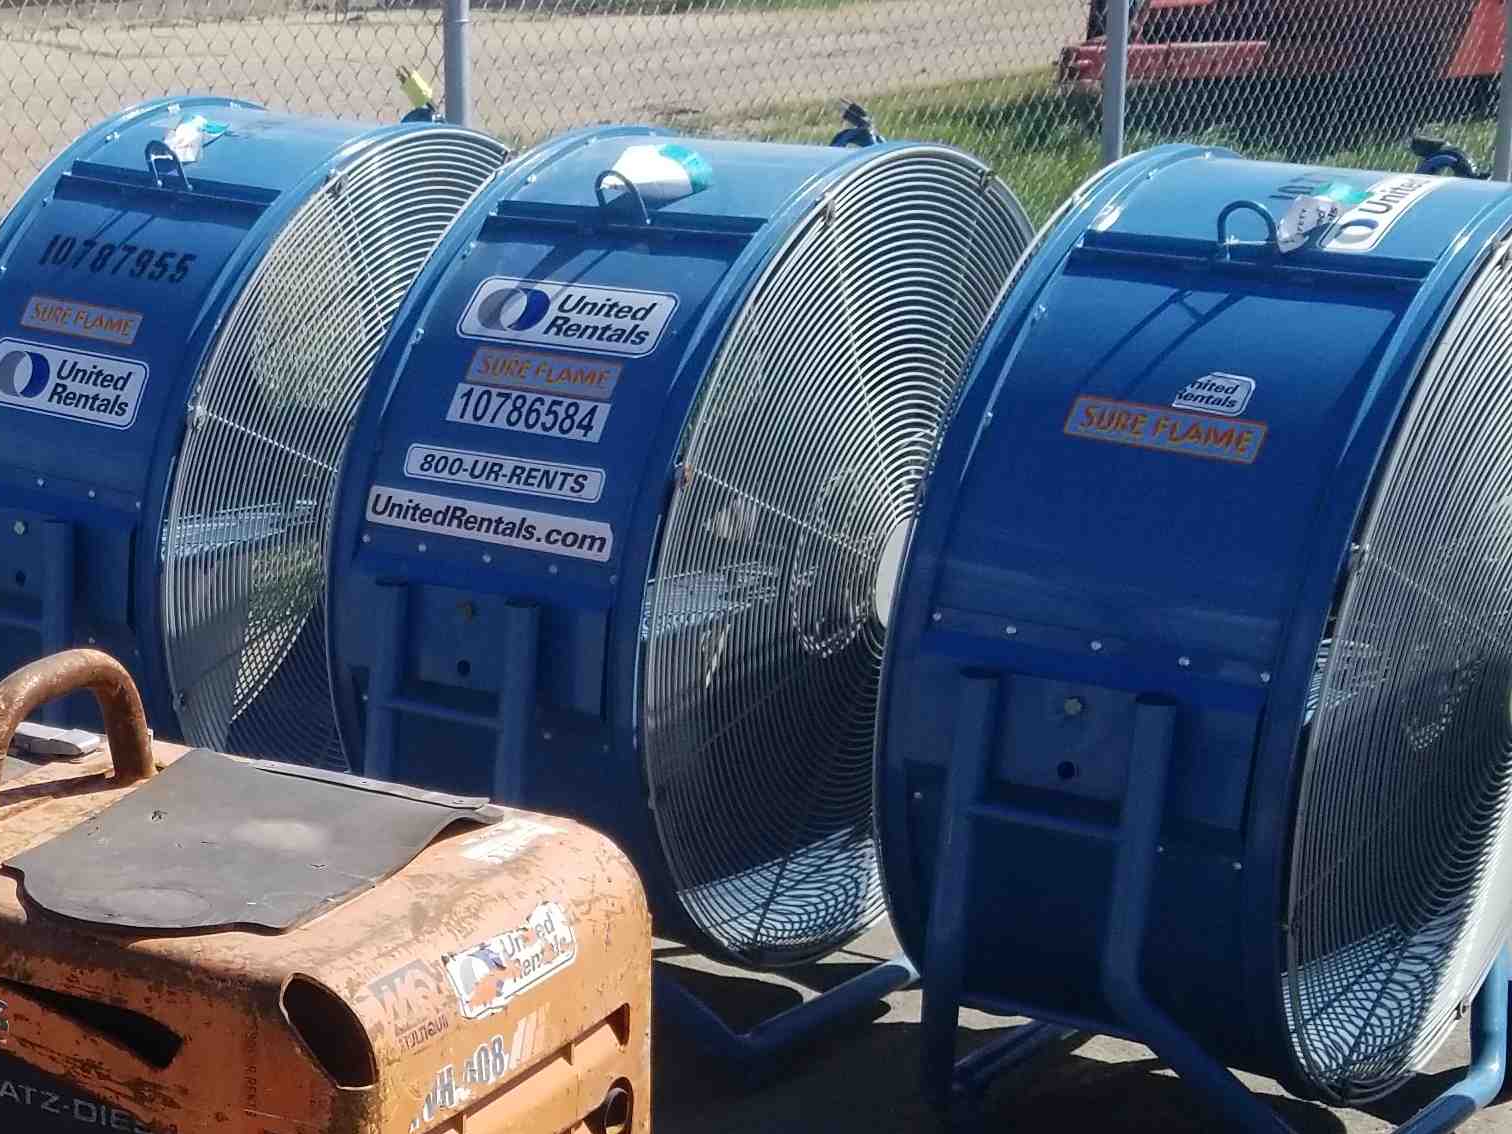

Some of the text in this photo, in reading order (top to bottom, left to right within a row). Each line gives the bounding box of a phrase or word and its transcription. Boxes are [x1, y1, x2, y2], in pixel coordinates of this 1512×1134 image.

[39, 234, 197, 283] 10787955
[34, 303, 133, 337] SURE FLAME
[557, 294, 657, 323] United
[543, 316, 651, 347] Rentals
[56, 359, 133, 391] United
[477, 354, 612, 386] SURE FLAME
[47, 382, 129, 417] Rentals
[1190, 379, 1240, 397] nited
[458, 387, 599, 438] 10786584
[1080, 406, 1256, 453] SURE FLAME
[419, 453, 589, 494] 800-UR-RENTS
[370, 494, 607, 553] UnitedRentals.com
